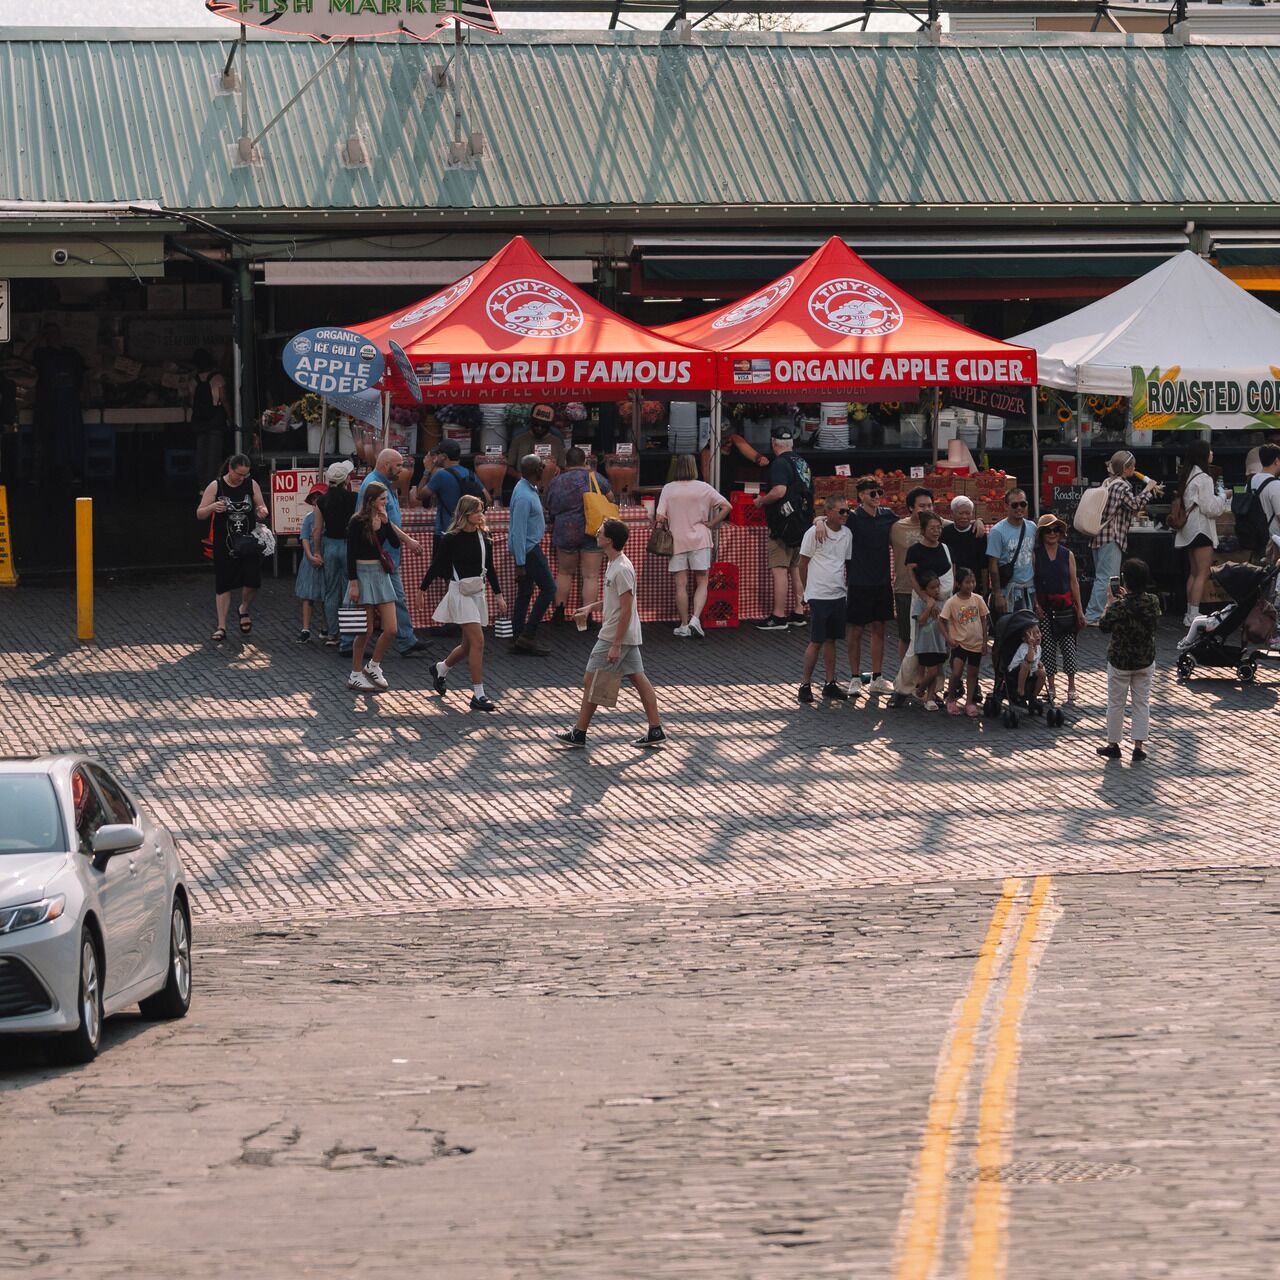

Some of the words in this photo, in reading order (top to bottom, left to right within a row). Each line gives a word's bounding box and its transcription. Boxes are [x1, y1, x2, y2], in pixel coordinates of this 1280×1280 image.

[316, 330, 360, 344] ORGANIC
[504, 322, 575, 336] ORGANIC
[827, 321, 895, 336] ORGANIC
[314, 342, 329, 354] ICE
[332, 344, 357, 357] COLD
[295, 356, 371, 378] APPLE
[461, 360, 566, 384] WORLD
[574, 360, 691, 383] FAMOUS
[775, 359, 874, 383] ORGANIC
[879, 358, 950, 381] APPLE
[955, 359, 1024, 382] CIDER
[294, 371, 368, 393] CIDER
[949, 386, 988, 406] APPLE
[990, 392, 1027, 415] CIDER
[1146, 380, 1243, 414] ROASTED
[276, 475, 294, 490] NO
[1054, 486, 1083, 501] Roasted
